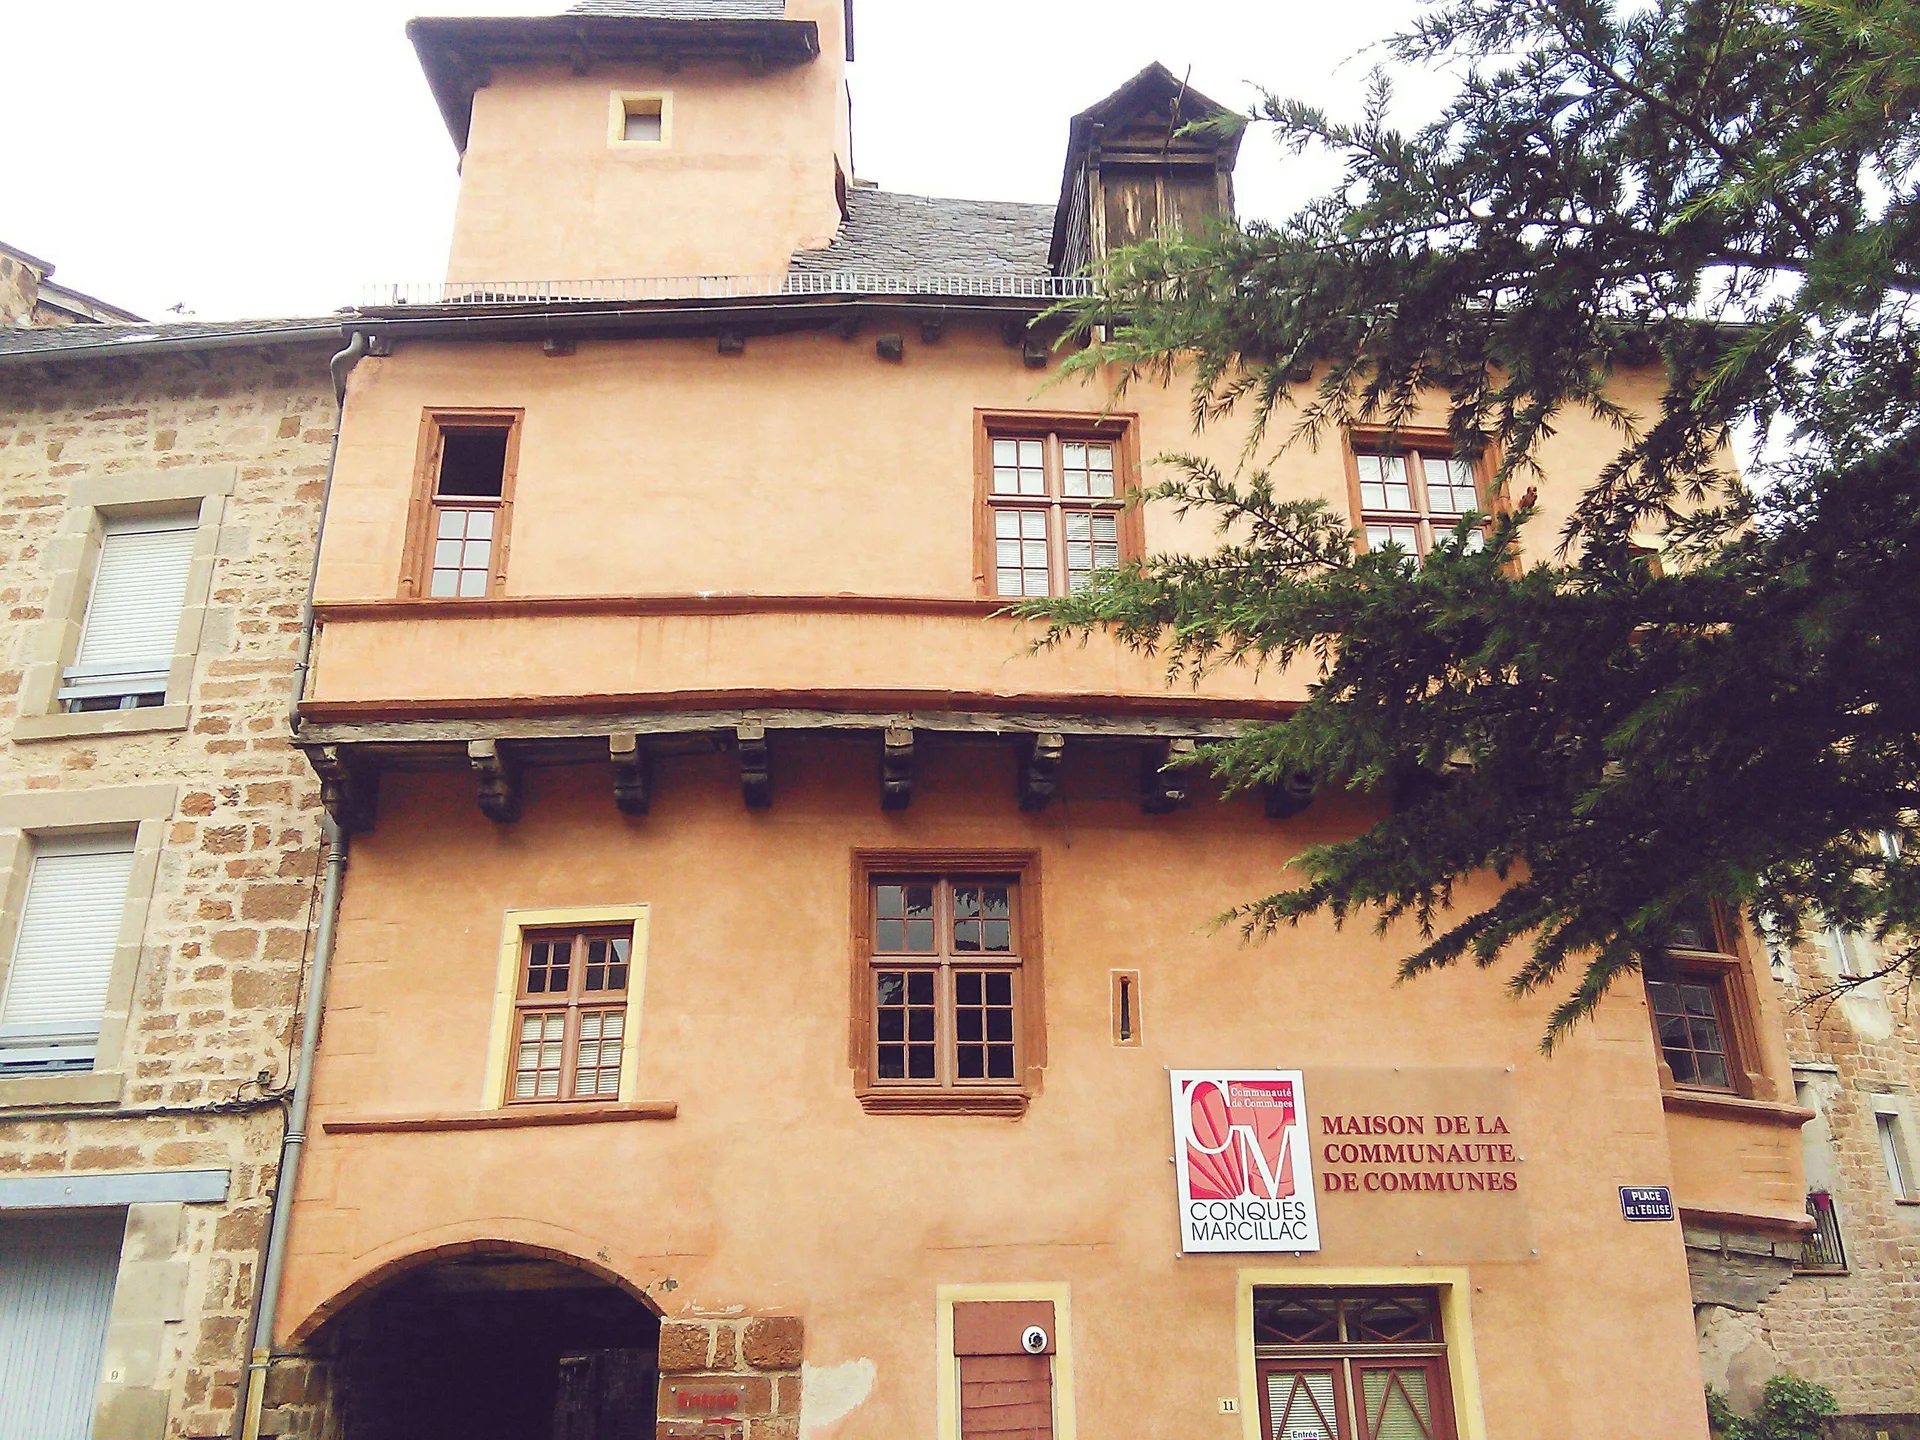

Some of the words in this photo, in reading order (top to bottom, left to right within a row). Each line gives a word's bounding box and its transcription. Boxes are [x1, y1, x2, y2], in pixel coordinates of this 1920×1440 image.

[1230, 1087, 1292, 1098] Communauté
[1231, 1098, 1242, 1108] de
[1244, 1098, 1293, 1108] Communes
[1321, 1115, 1424, 1135] MAISON
[1434, 1115, 1470, 1135] DE
[1475, 1115, 1510, 1135] LA
[1323, 1143, 1515, 1164] COMMUNAUTE
[1322, 1172, 1359, 1192] DE
[1363, 1171, 1518, 1192] COMMUNES
[1631, 1191, 1661, 1201] PLACE
[1190, 1202, 1306, 1221] CONQUES
[1626, 1206, 1635, 1215] DE
[1191, 1222, 1308, 1241] MARCILLAC
[110, 1370, 119, 1381] 9
[677, 1391, 738, 1409] Entrée
[1223, 1400, 1234, 1411] 11
